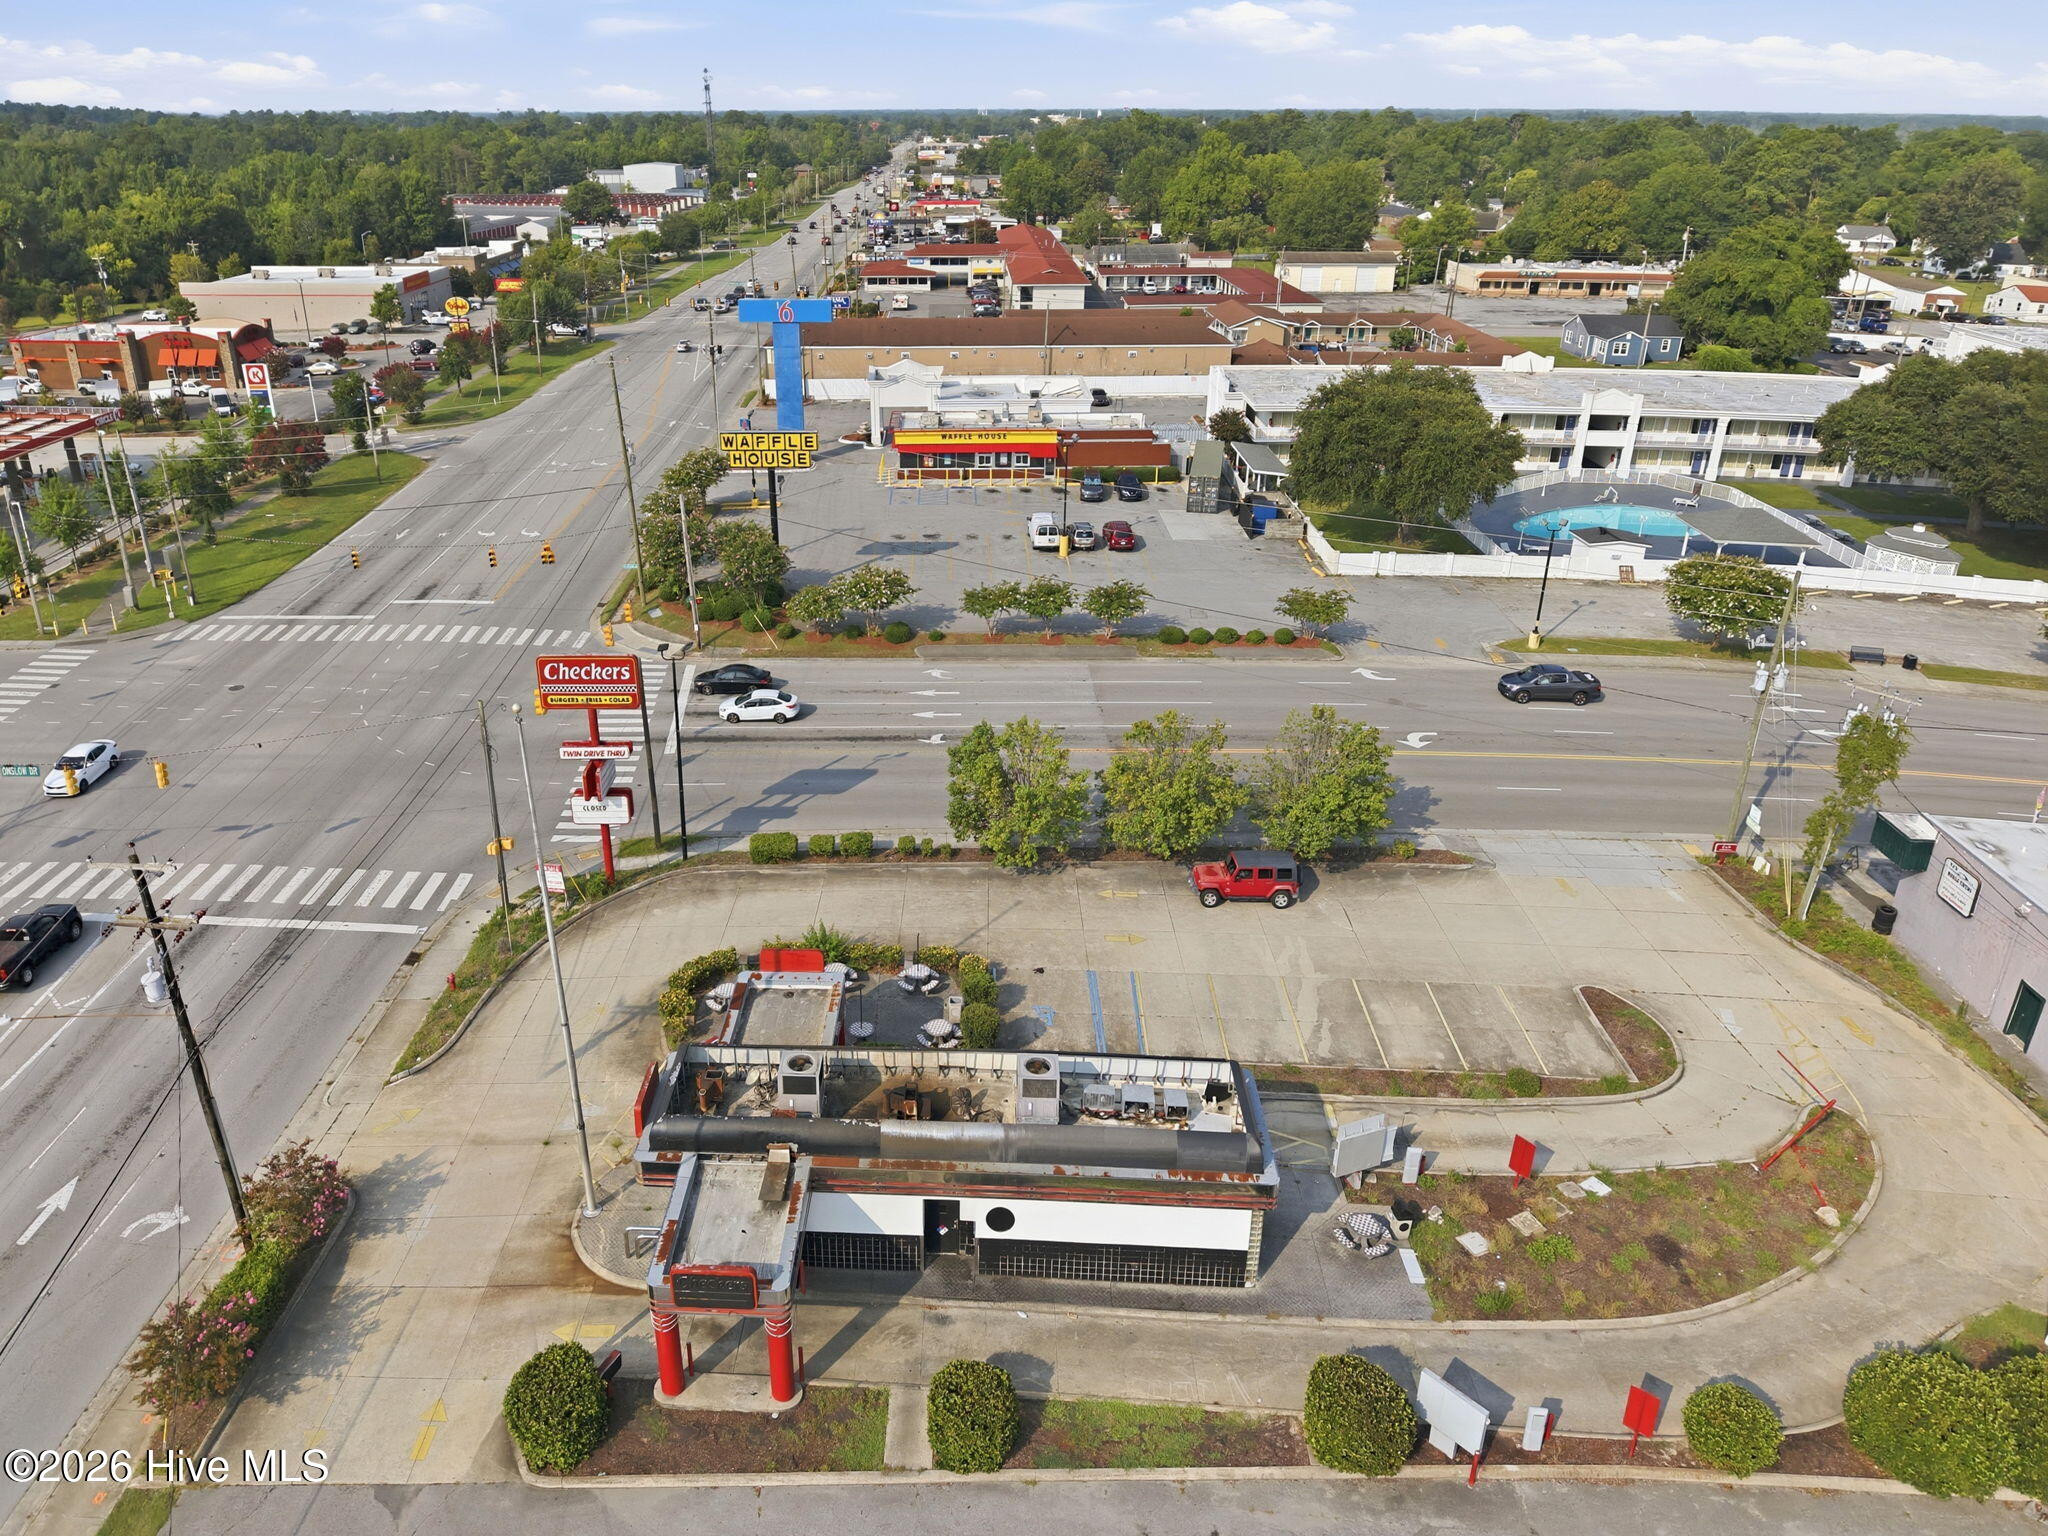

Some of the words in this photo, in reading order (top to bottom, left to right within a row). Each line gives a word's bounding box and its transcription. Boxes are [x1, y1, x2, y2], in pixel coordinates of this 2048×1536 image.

[778, 300, 795, 322] 6
[722, 436, 814, 448] WAFFLE
[733, 453, 807, 465] HOUSE
[543, 663, 631, 680] Checkers
[2, 766, 28, 776] ONSLOW
[29, 766, 39, 776] DR
